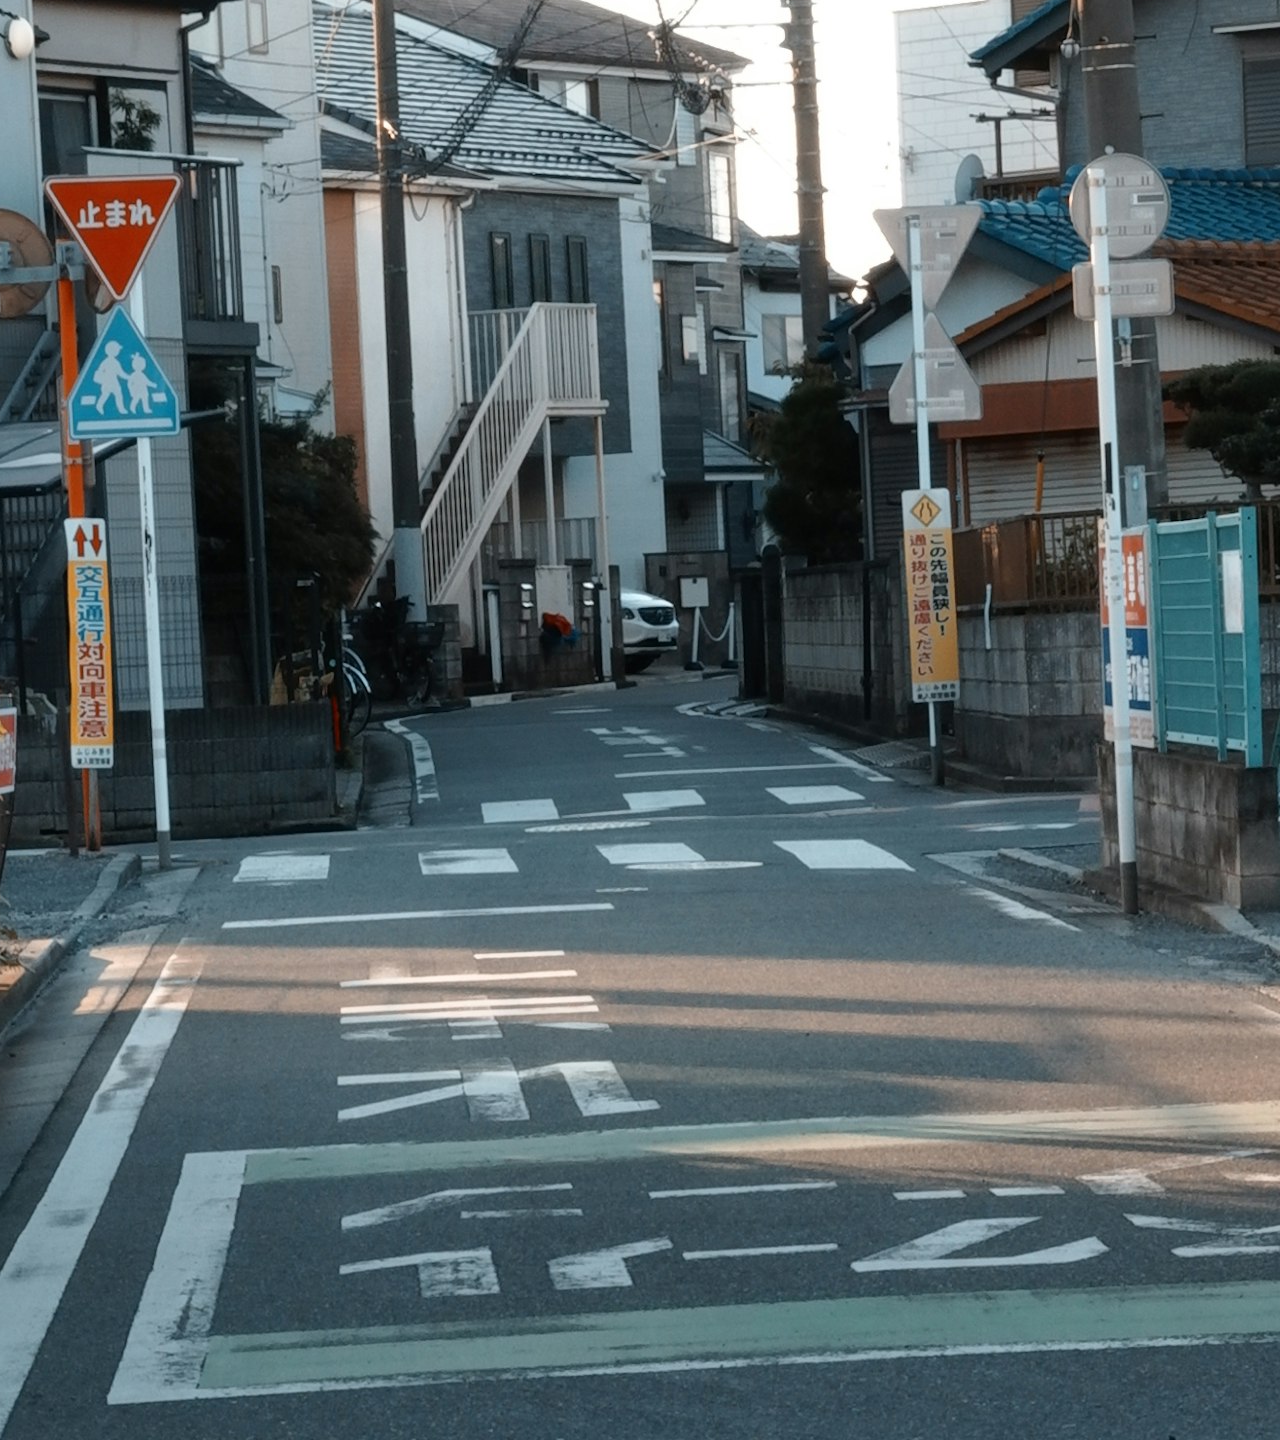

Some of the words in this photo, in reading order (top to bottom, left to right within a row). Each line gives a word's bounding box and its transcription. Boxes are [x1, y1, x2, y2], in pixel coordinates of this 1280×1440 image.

[76, 198, 156, 229] 止まれ
[75, 566, 108, 738] 交互通行対向車注意
[909, 534, 934, 676] 通り抜けご遠慮ください
